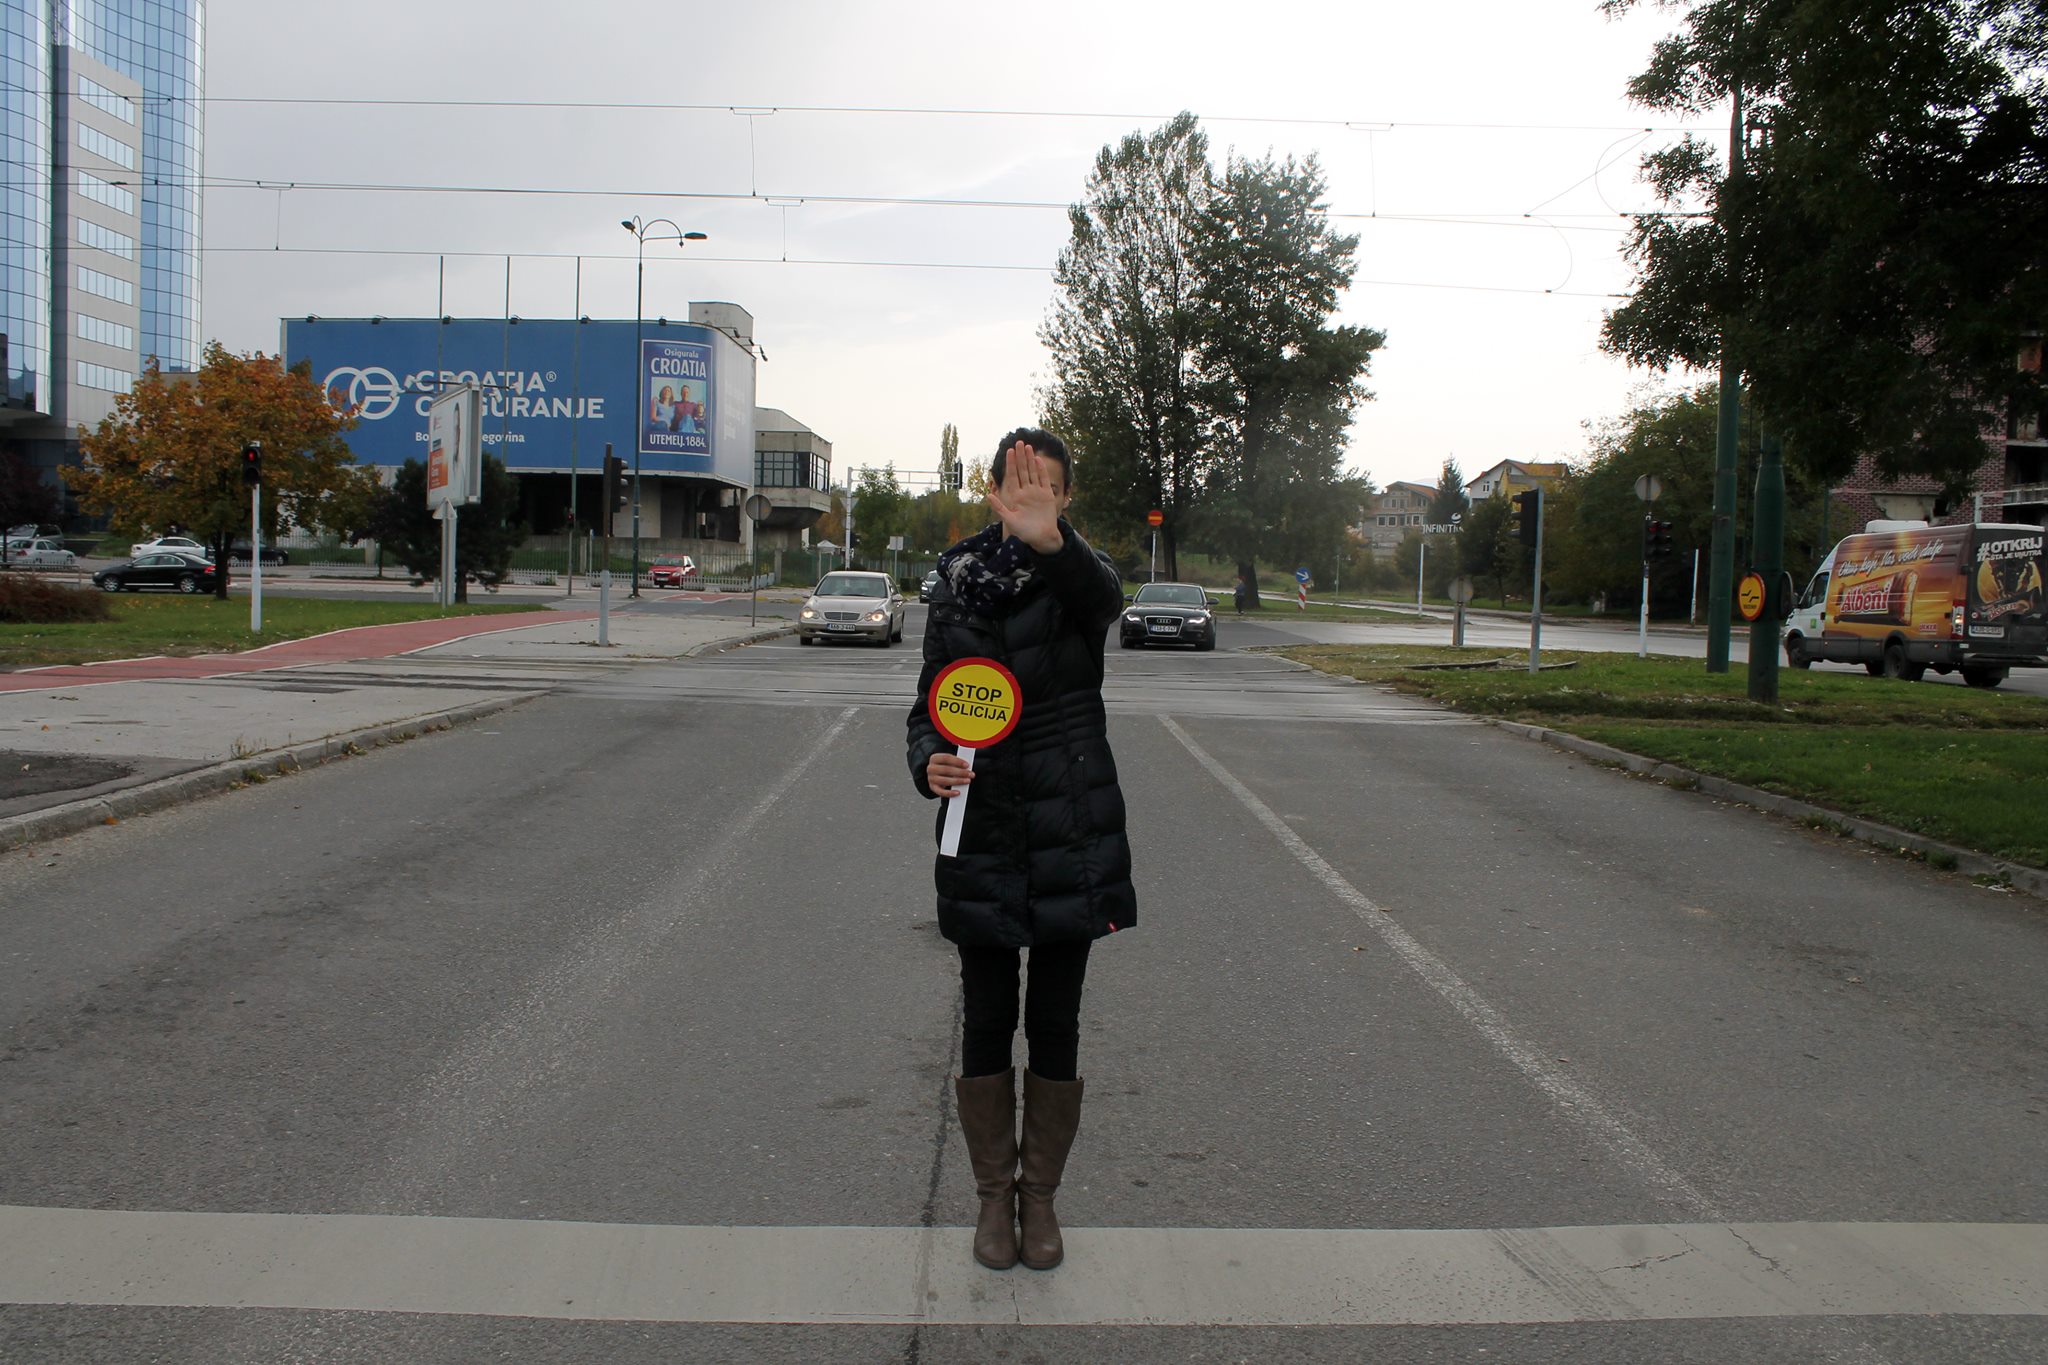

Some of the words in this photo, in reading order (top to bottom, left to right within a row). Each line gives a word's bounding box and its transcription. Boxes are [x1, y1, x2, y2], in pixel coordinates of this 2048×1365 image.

[664, 348, 699, 359] Osigurala
[650, 357, 707, 378] CROATIA
[415, 395, 604, 418] OURANJE
[482, 431, 525, 445] egovina
[1840, 583, 1891, 614] Albeni
[952, 682, 1002, 702] STOP
[938, 700, 1007, 722] POLICIJA
